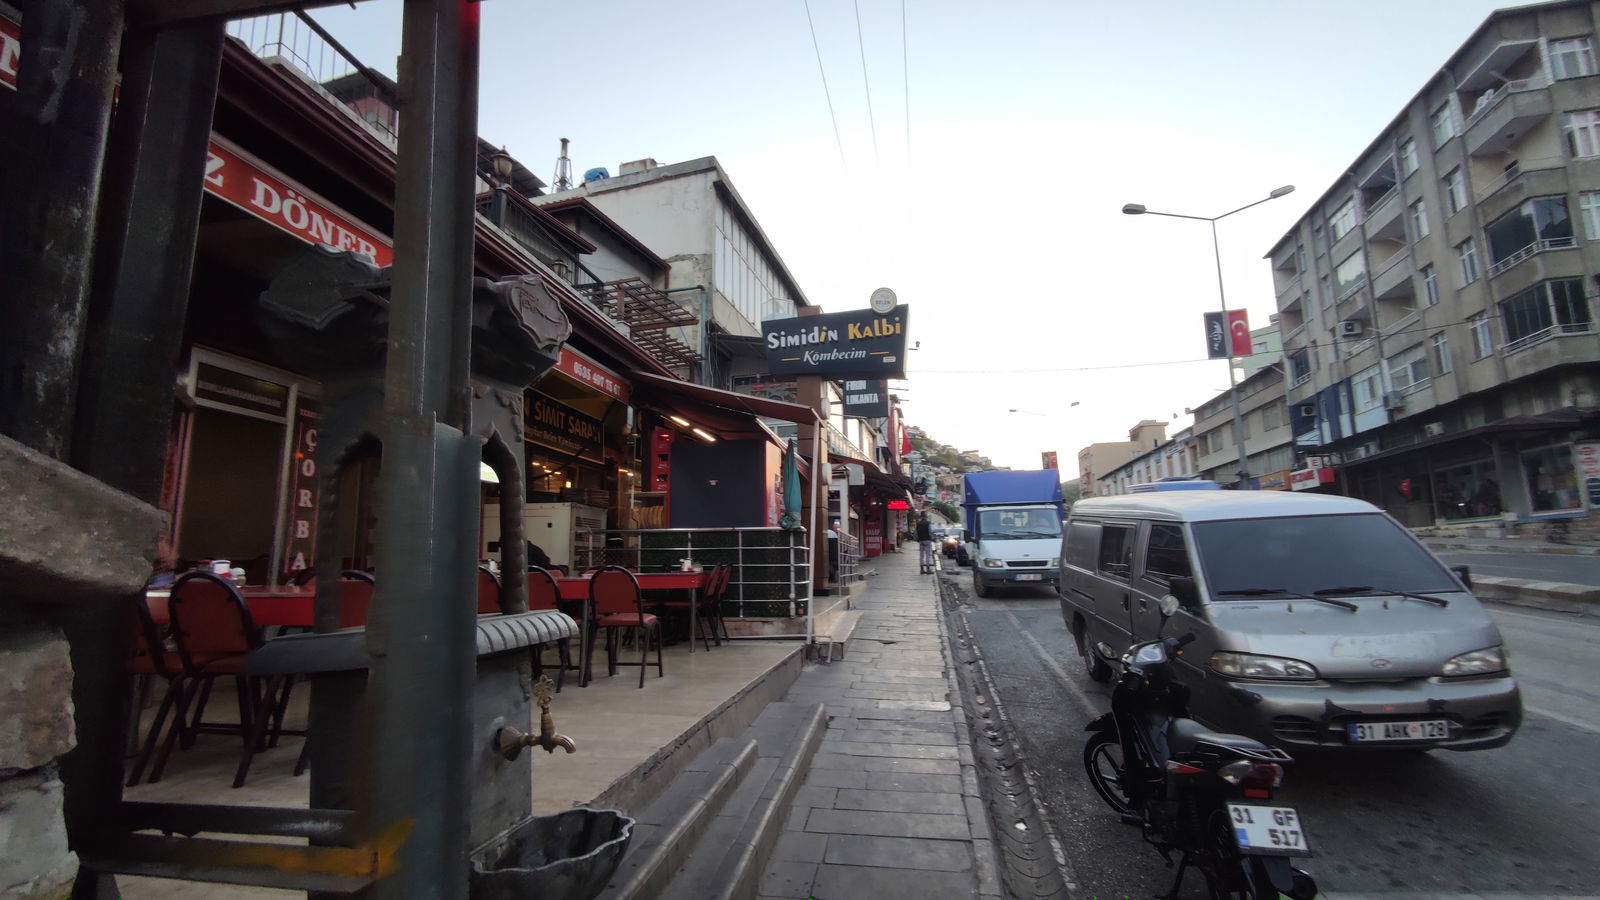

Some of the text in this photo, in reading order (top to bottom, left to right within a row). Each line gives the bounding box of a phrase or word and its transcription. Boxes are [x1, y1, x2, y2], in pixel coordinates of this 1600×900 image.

[250, 177, 381, 268] DÖNER
[803, 347, 867, 366] Kömbecim
[1358, 722, 1446, 739] 31 AHK 128
[1232, 807, 1296, 826] 31 GF
[1268, 828, 1300, 847] 517
